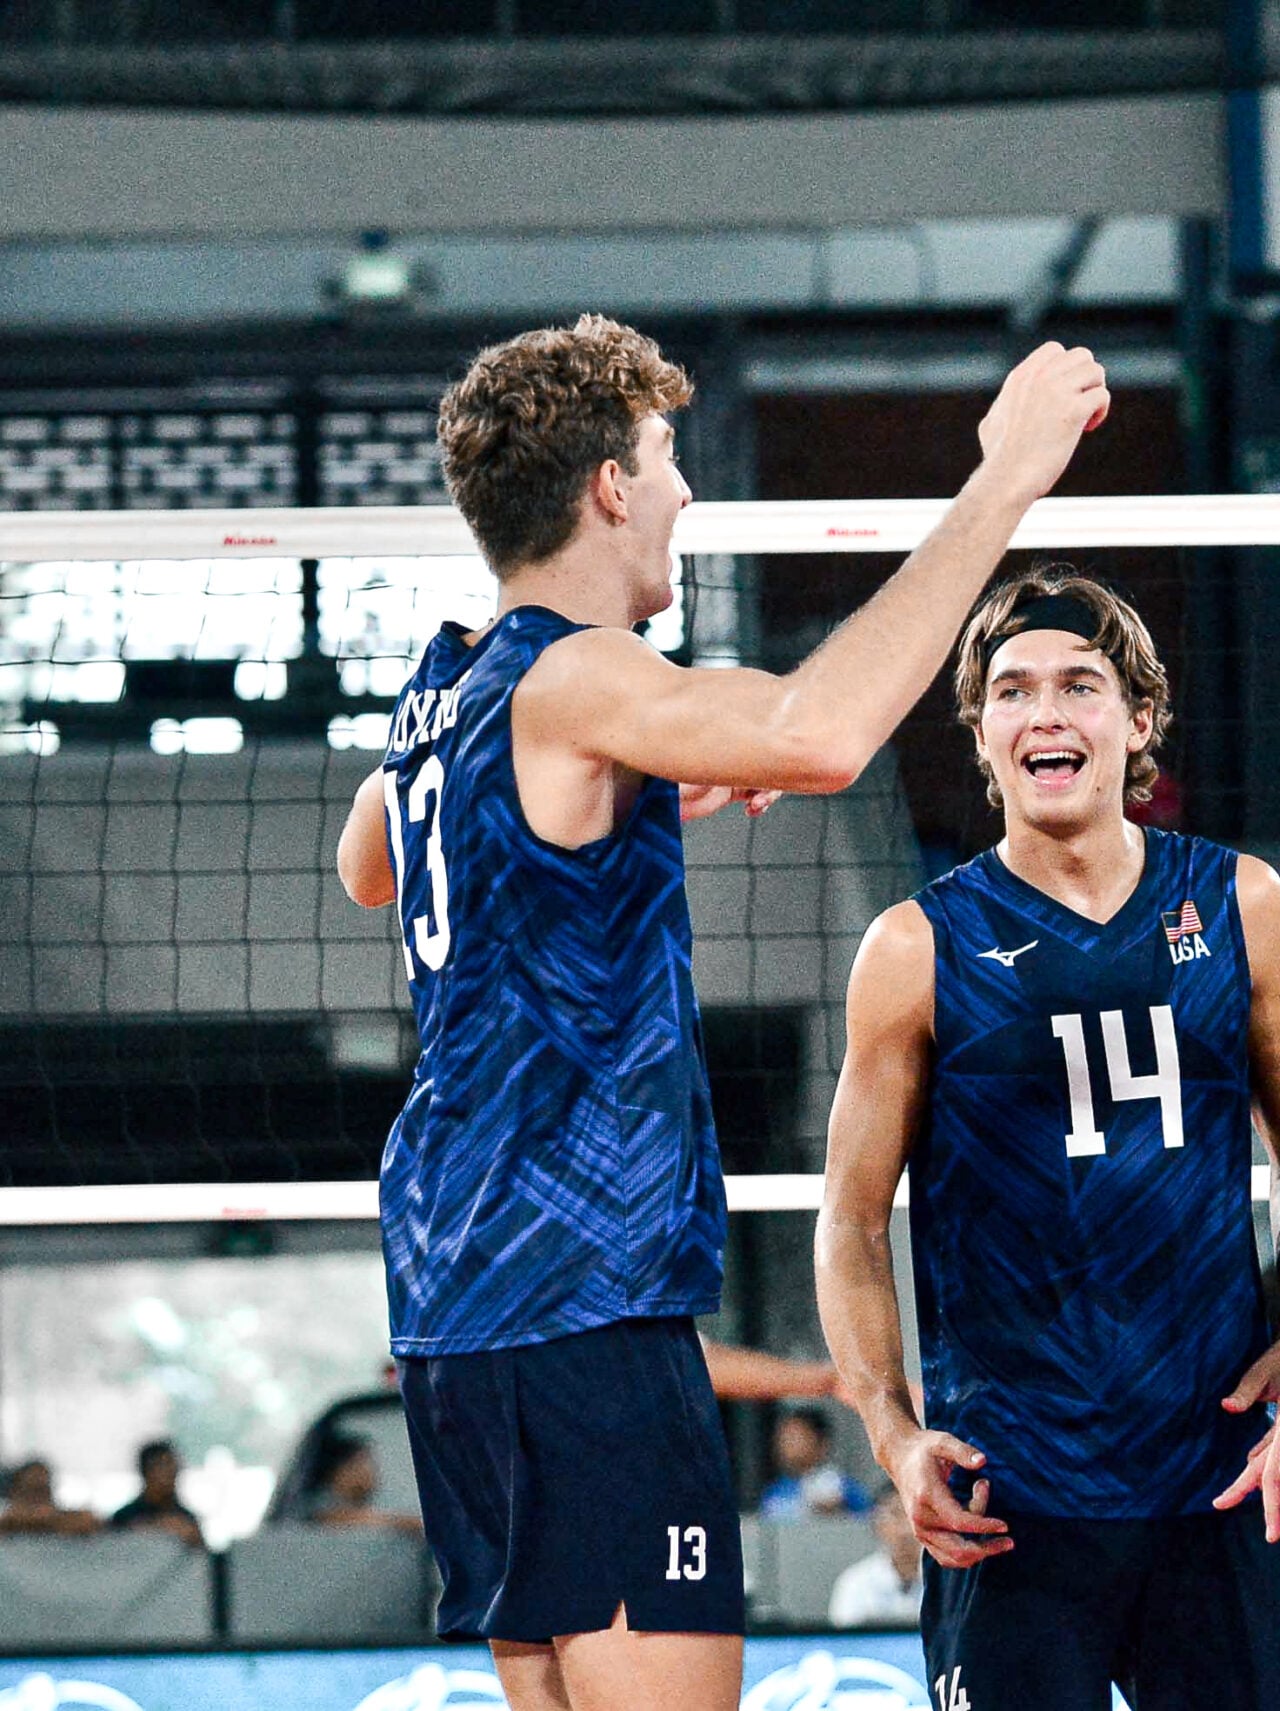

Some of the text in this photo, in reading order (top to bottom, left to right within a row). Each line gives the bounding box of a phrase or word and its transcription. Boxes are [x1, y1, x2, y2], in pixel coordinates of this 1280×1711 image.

[384, 754, 451, 982] 13
[1168, 933, 1212, 965] USA
[1051, 1004, 1184, 1158] 14
[665, 1526, 706, 1580] 13
[935, 1665, 971, 1711] 14
